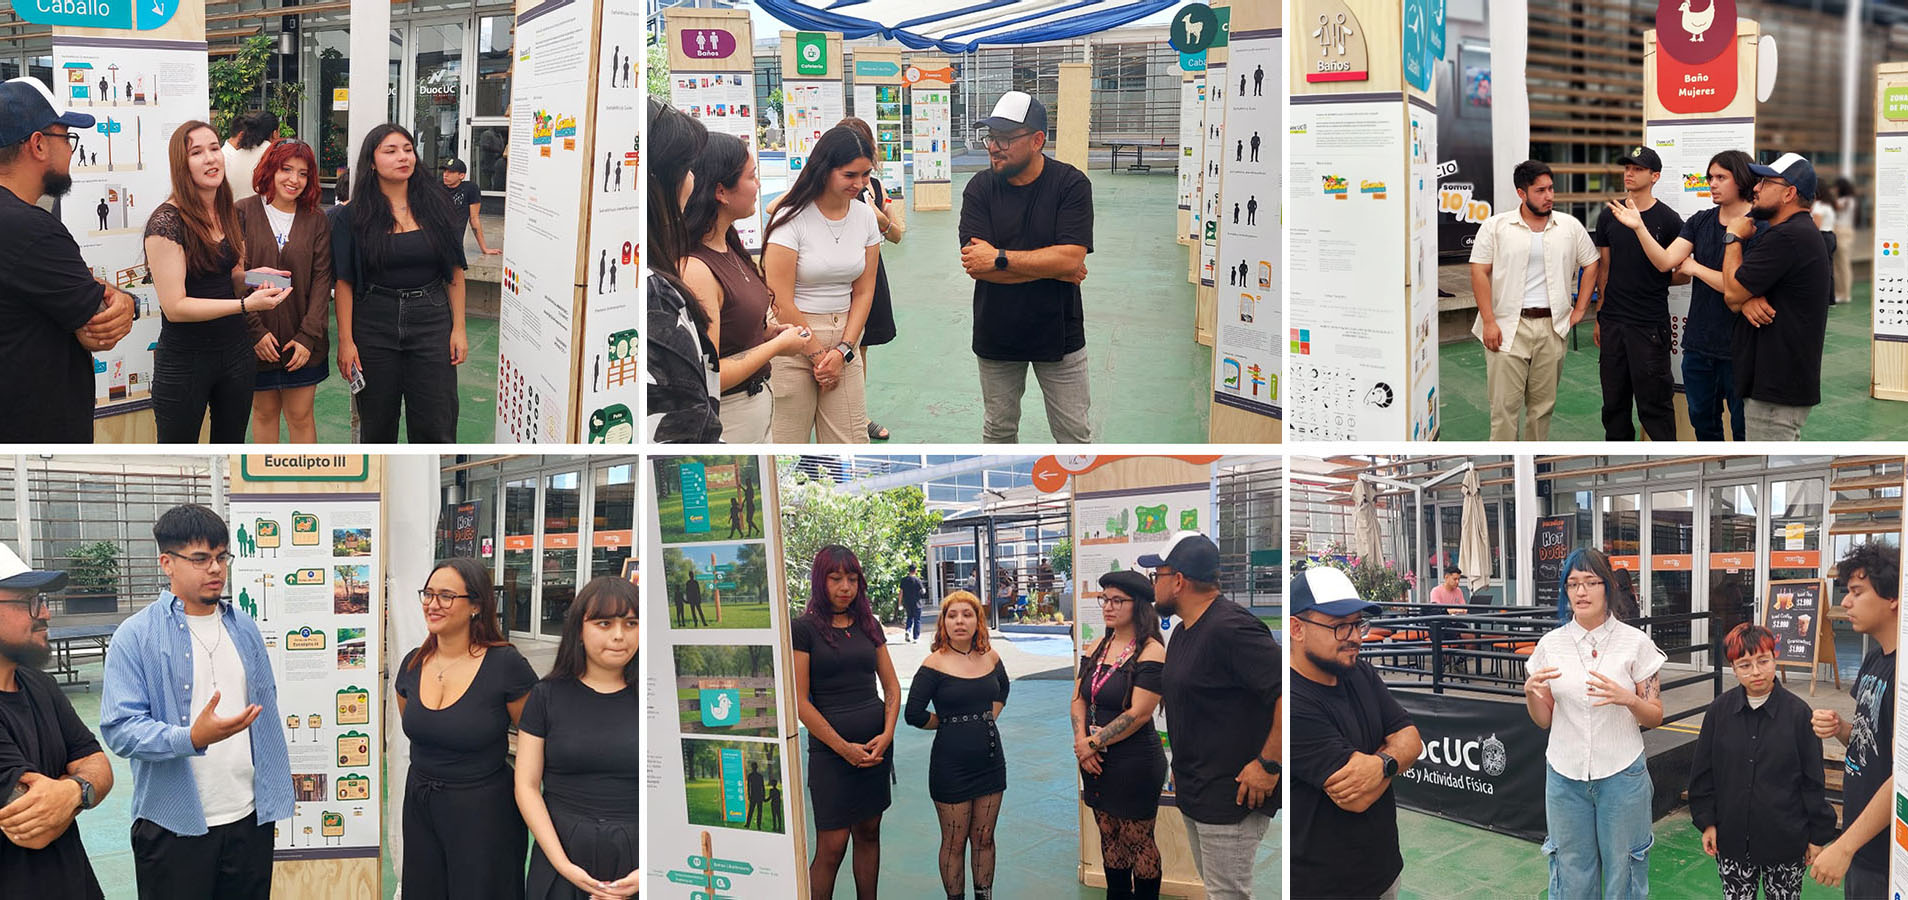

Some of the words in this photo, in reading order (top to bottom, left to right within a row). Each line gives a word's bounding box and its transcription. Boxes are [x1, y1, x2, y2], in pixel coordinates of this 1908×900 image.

[37, 0, 110, 16] Caballo
[1317, 59, 1351, 72] Baños
[1684, 73, 1709, 83] Baño
[1679, 87, 1715, 98] Mujeres
[264, 454, 330, 470] Eucalipto
[333, 456, 346, 467] III
[1542, 532, 1564, 547] HOT
[1416, 769, 1422, 783] y
[1423, 767, 1465, 789] Actividad
[1465, 776, 1494, 795] Física
